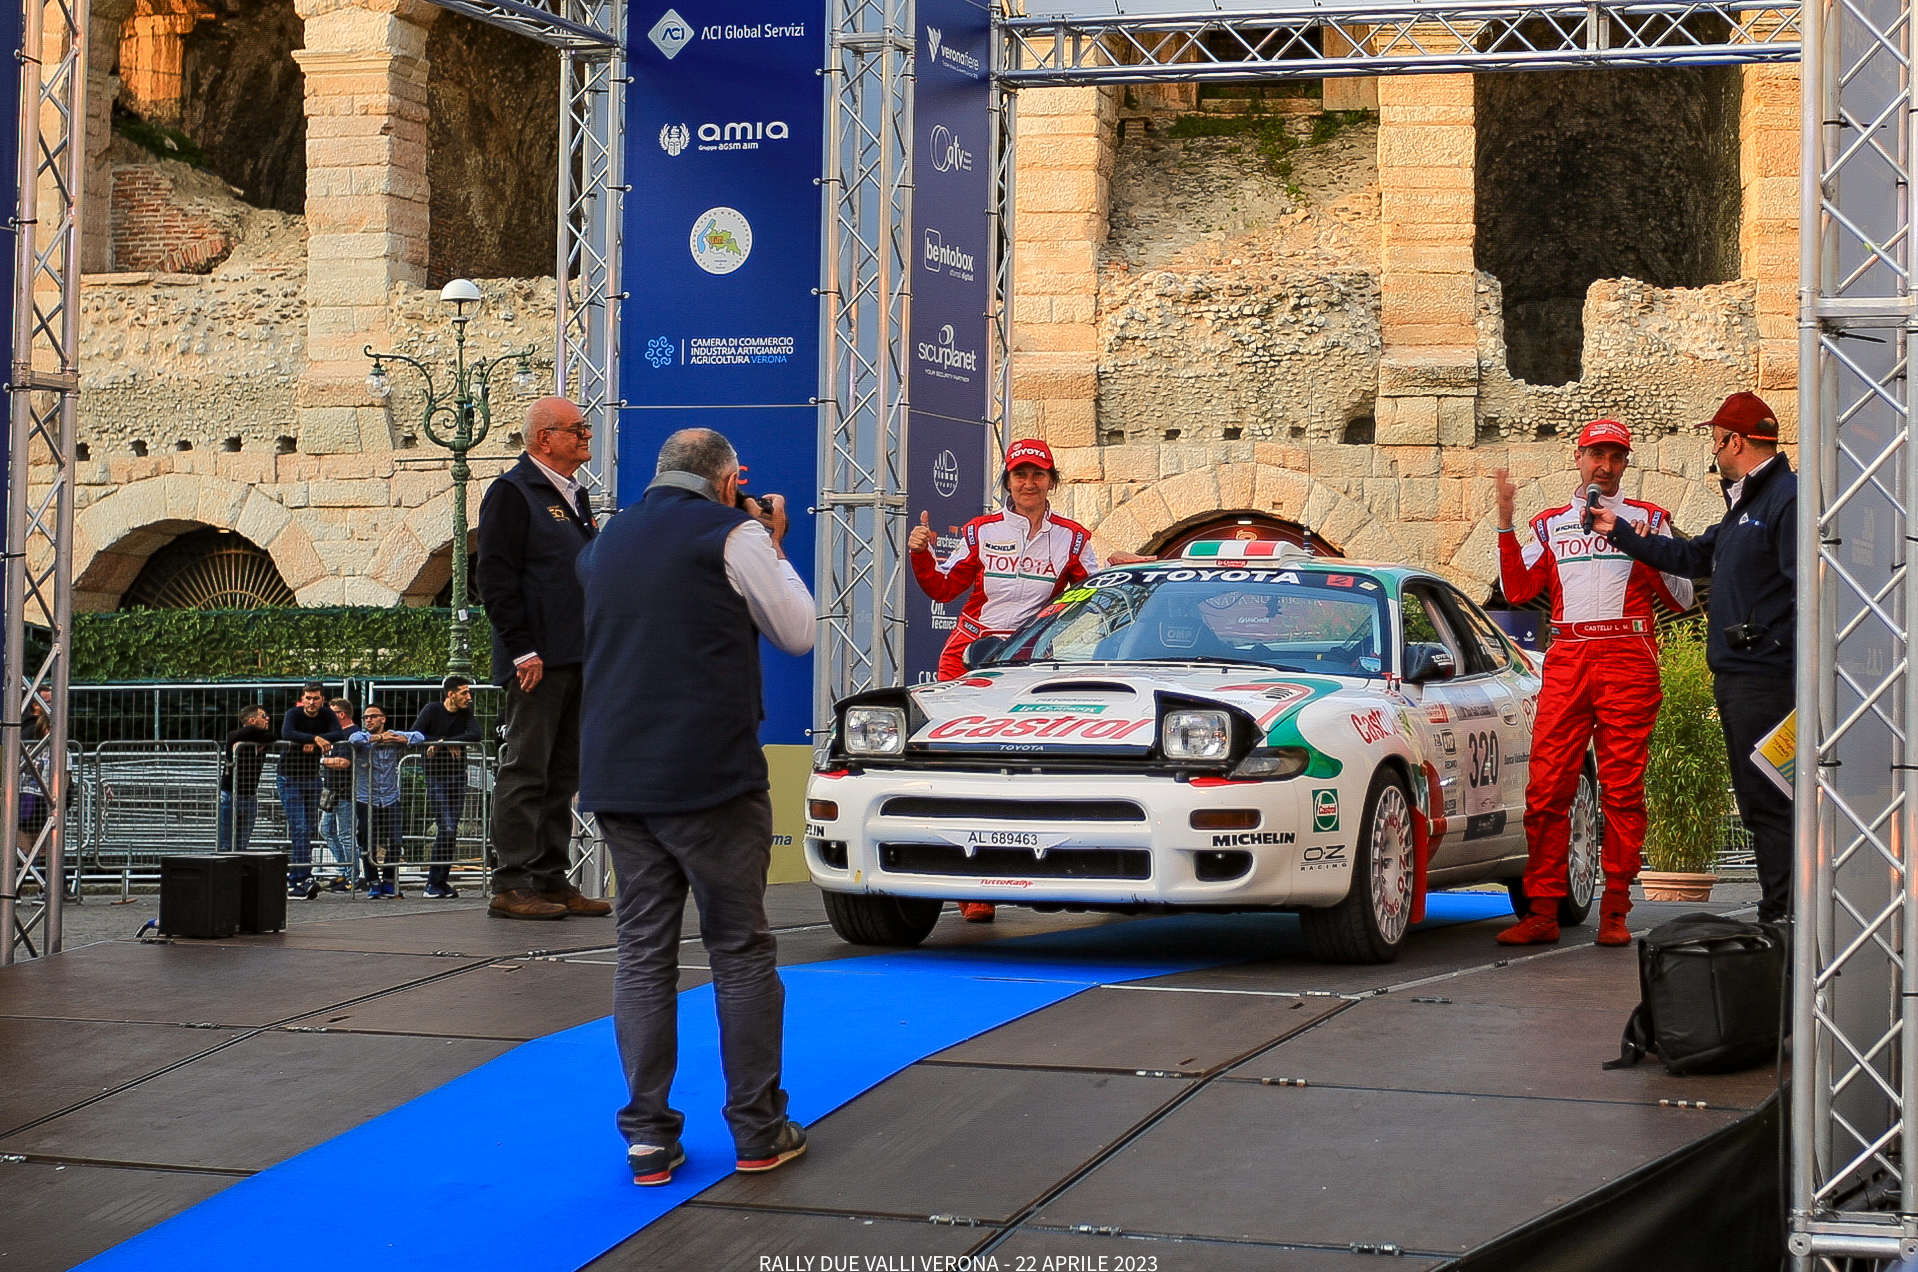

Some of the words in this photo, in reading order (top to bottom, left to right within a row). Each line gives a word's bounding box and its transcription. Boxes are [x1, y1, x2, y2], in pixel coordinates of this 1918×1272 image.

[661, 27, 685, 41] ACI
[701, 26, 721, 40] ACI
[725, 24, 761, 39] Global
[764, 22, 805, 38] Servizi
[941, 45, 979, 71] veronafiere
[697, 121, 789, 141] amia
[947, 135, 965, 171] atv
[926, 237, 974, 272] bentobox
[690, 338, 726, 347] CAMERA
[727, 338, 737, 347] DI
[737, 337, 793, 346] COMMERCIO
[690, 347, 736, 356] INDUSTRIA
[736, 346, 793, 355] ARTIGIANATO
[918, 340, 976, 371] sicurplanet
[689, 356, 750, 365] AGRICOLTURA
[750, 355, 787, 364] VERONA
[1010, 448, 1046, 459] TOYOTA
[1555, 523, 1584, 533] MICHEL
[985, 541, 1017, 552] MICHELIN
[985, 554, 1057, 576] TOYOTA
[1142, 570, 1301, 585] TOYOTA
[1167, 629, 1192, 639] OMP
[927, 715, 1155, 739] Castrol
[999, 744, 1045, 752] TOYOTA
[1468, 730, 1499, 789] 320
[1318, 805, 1336, 815] Castrol
[805, 823, 825, 837] ELIN
[772, 835, 793, 845] ma
[968, 831, 988, 844] AL
[991, 832, 1038, 846] 689463
[1213, 832, 1295, 847] MICHELIN
[1301, 863, 1347, 871] RACING
